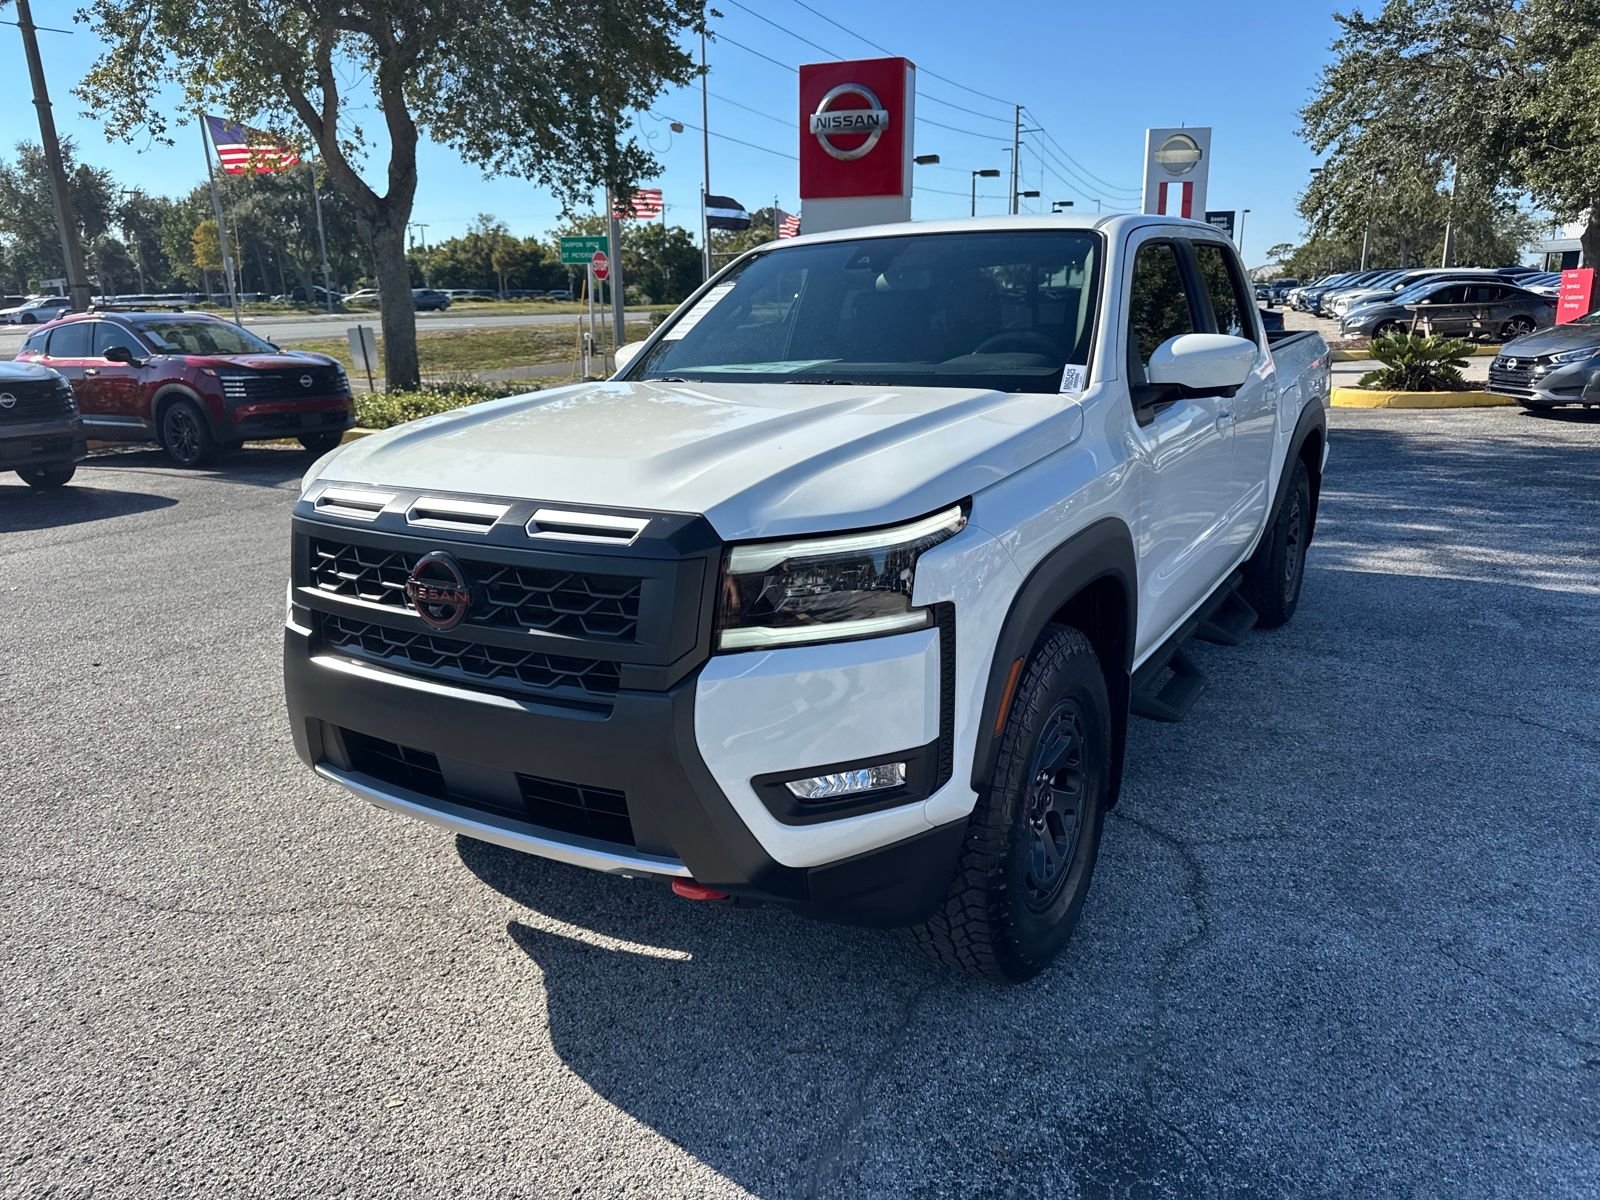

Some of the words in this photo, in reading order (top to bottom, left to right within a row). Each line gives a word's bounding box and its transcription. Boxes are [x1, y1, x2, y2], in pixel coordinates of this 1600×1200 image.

[815, 114, 880, 129] NISSAN
[593, 260, 608, 271] STOP
[406, 584, 468, 602] NISSAN
